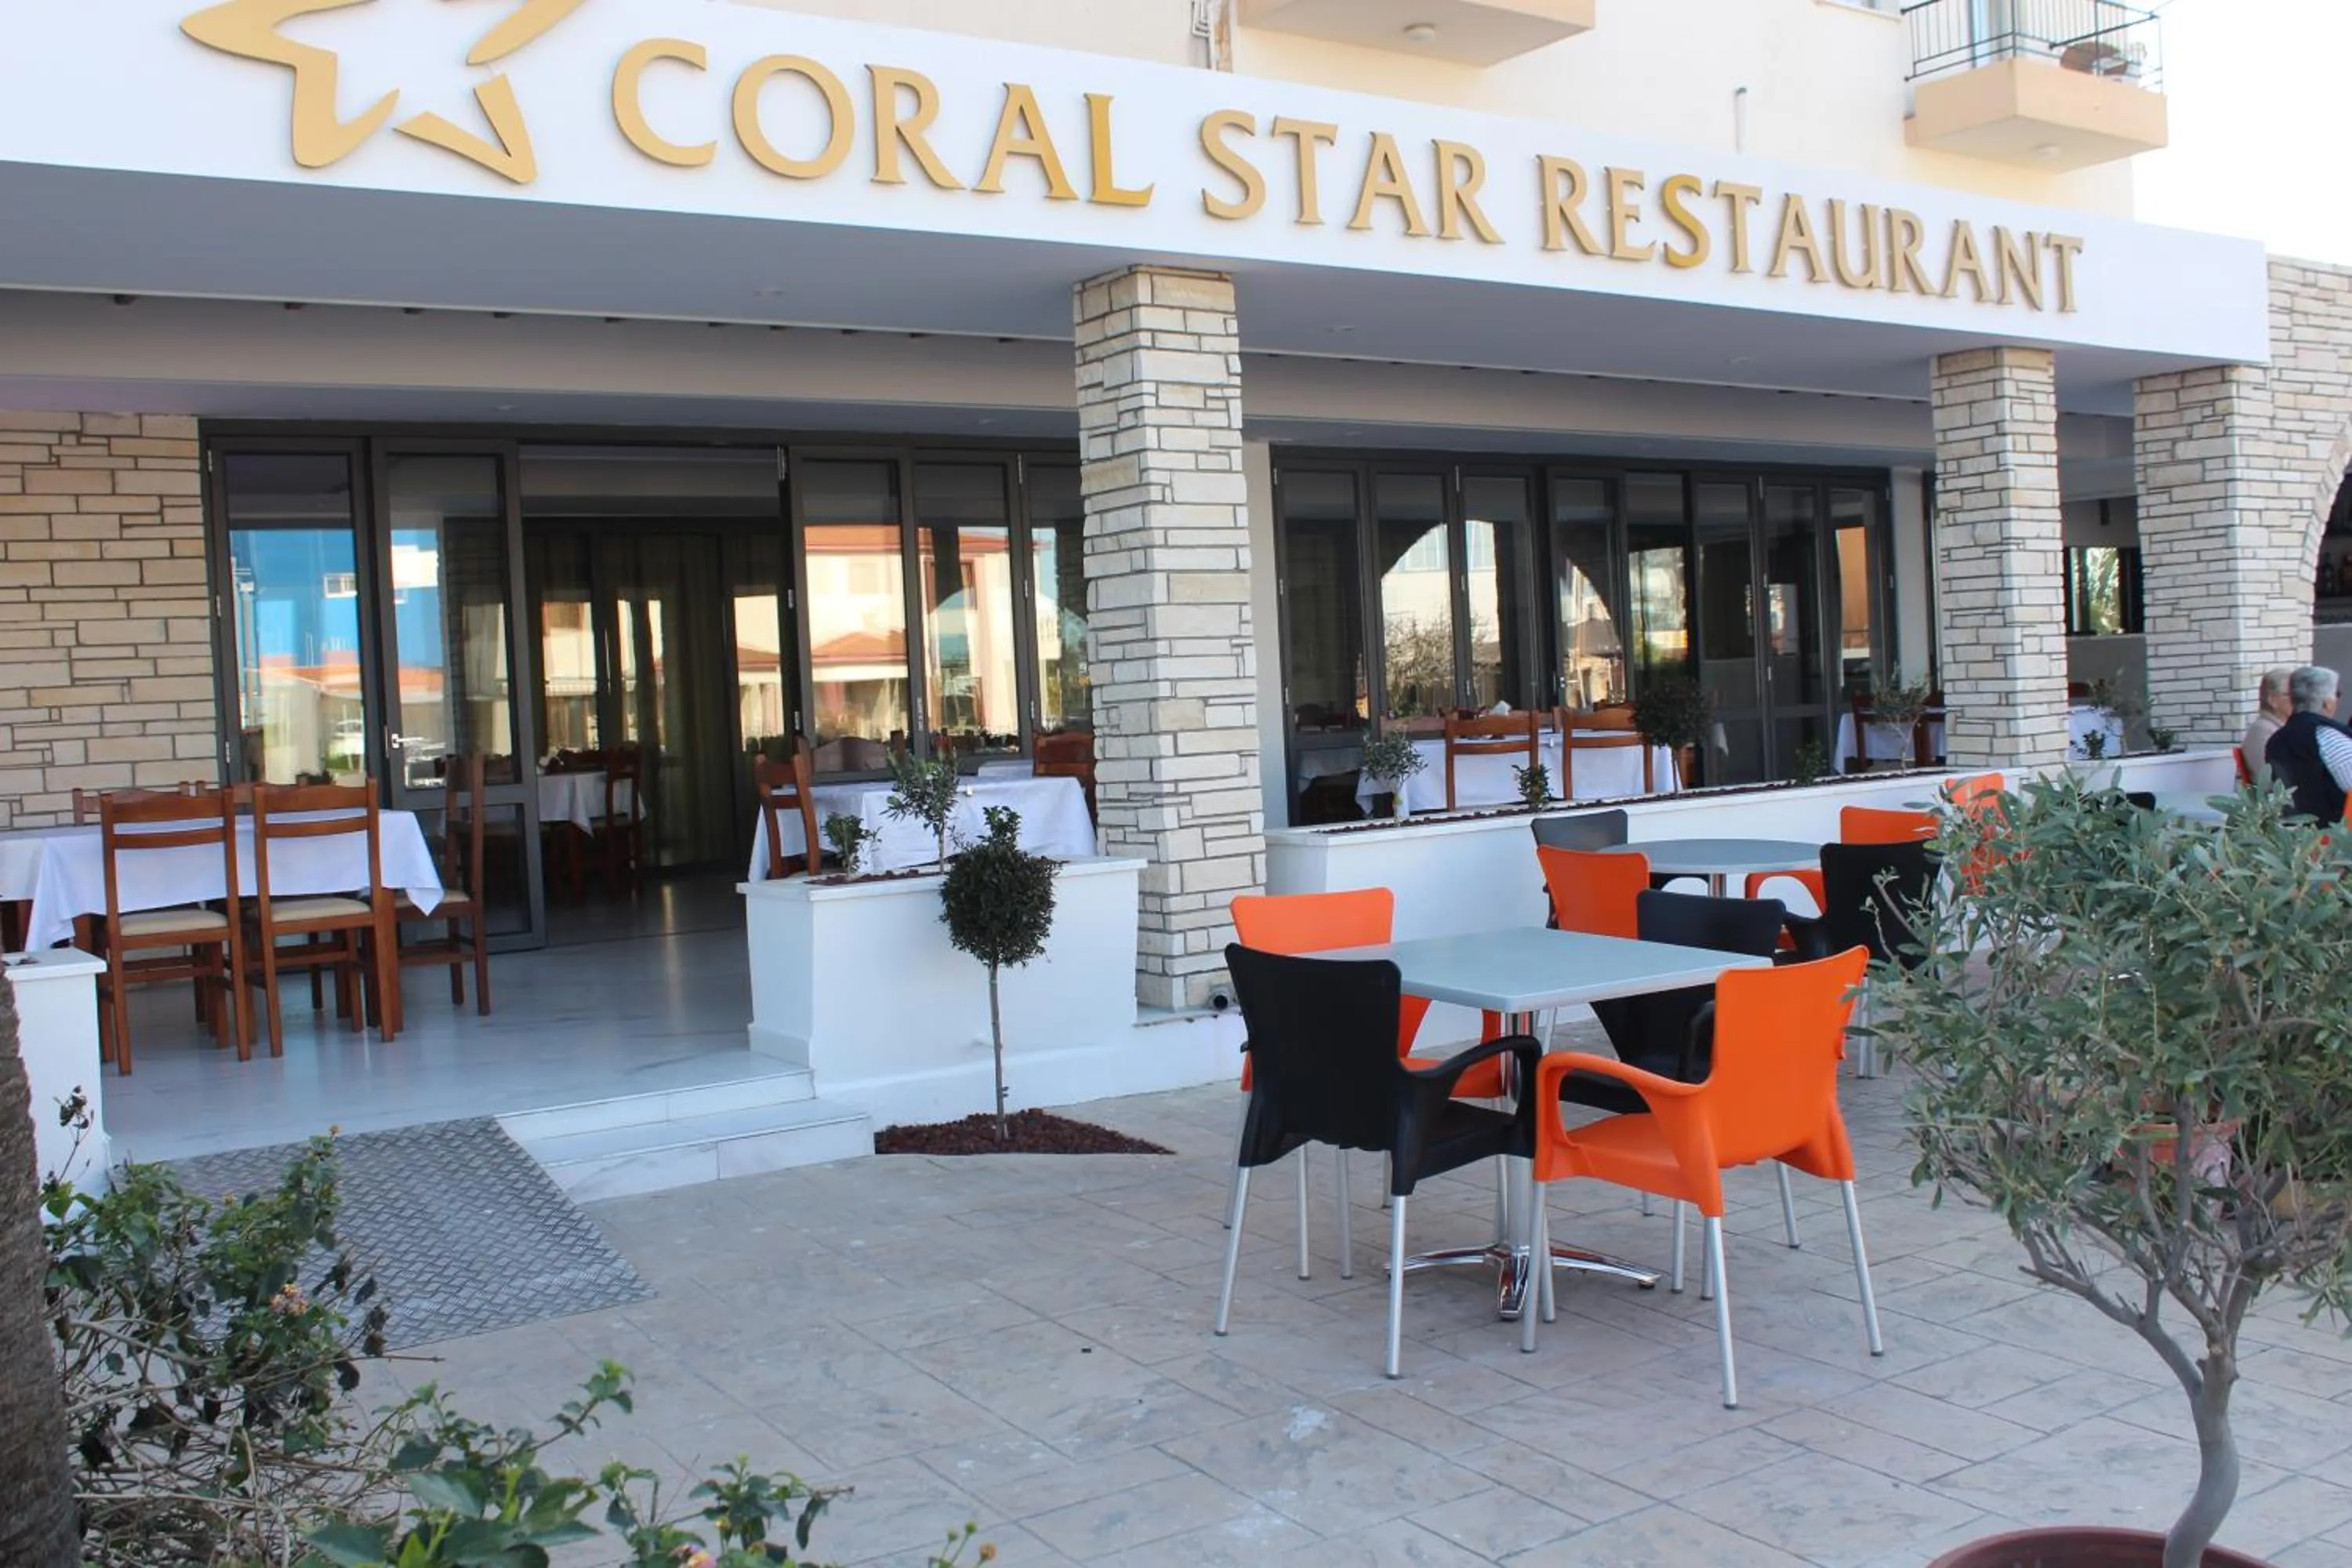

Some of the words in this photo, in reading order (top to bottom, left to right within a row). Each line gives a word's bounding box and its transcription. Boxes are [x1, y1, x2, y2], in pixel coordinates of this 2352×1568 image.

[611, 37, 1155, 208] CORAL
[1198, 109, 1505, 244] STAR
[1535, 154, 2084, 314] RESTAURANT
